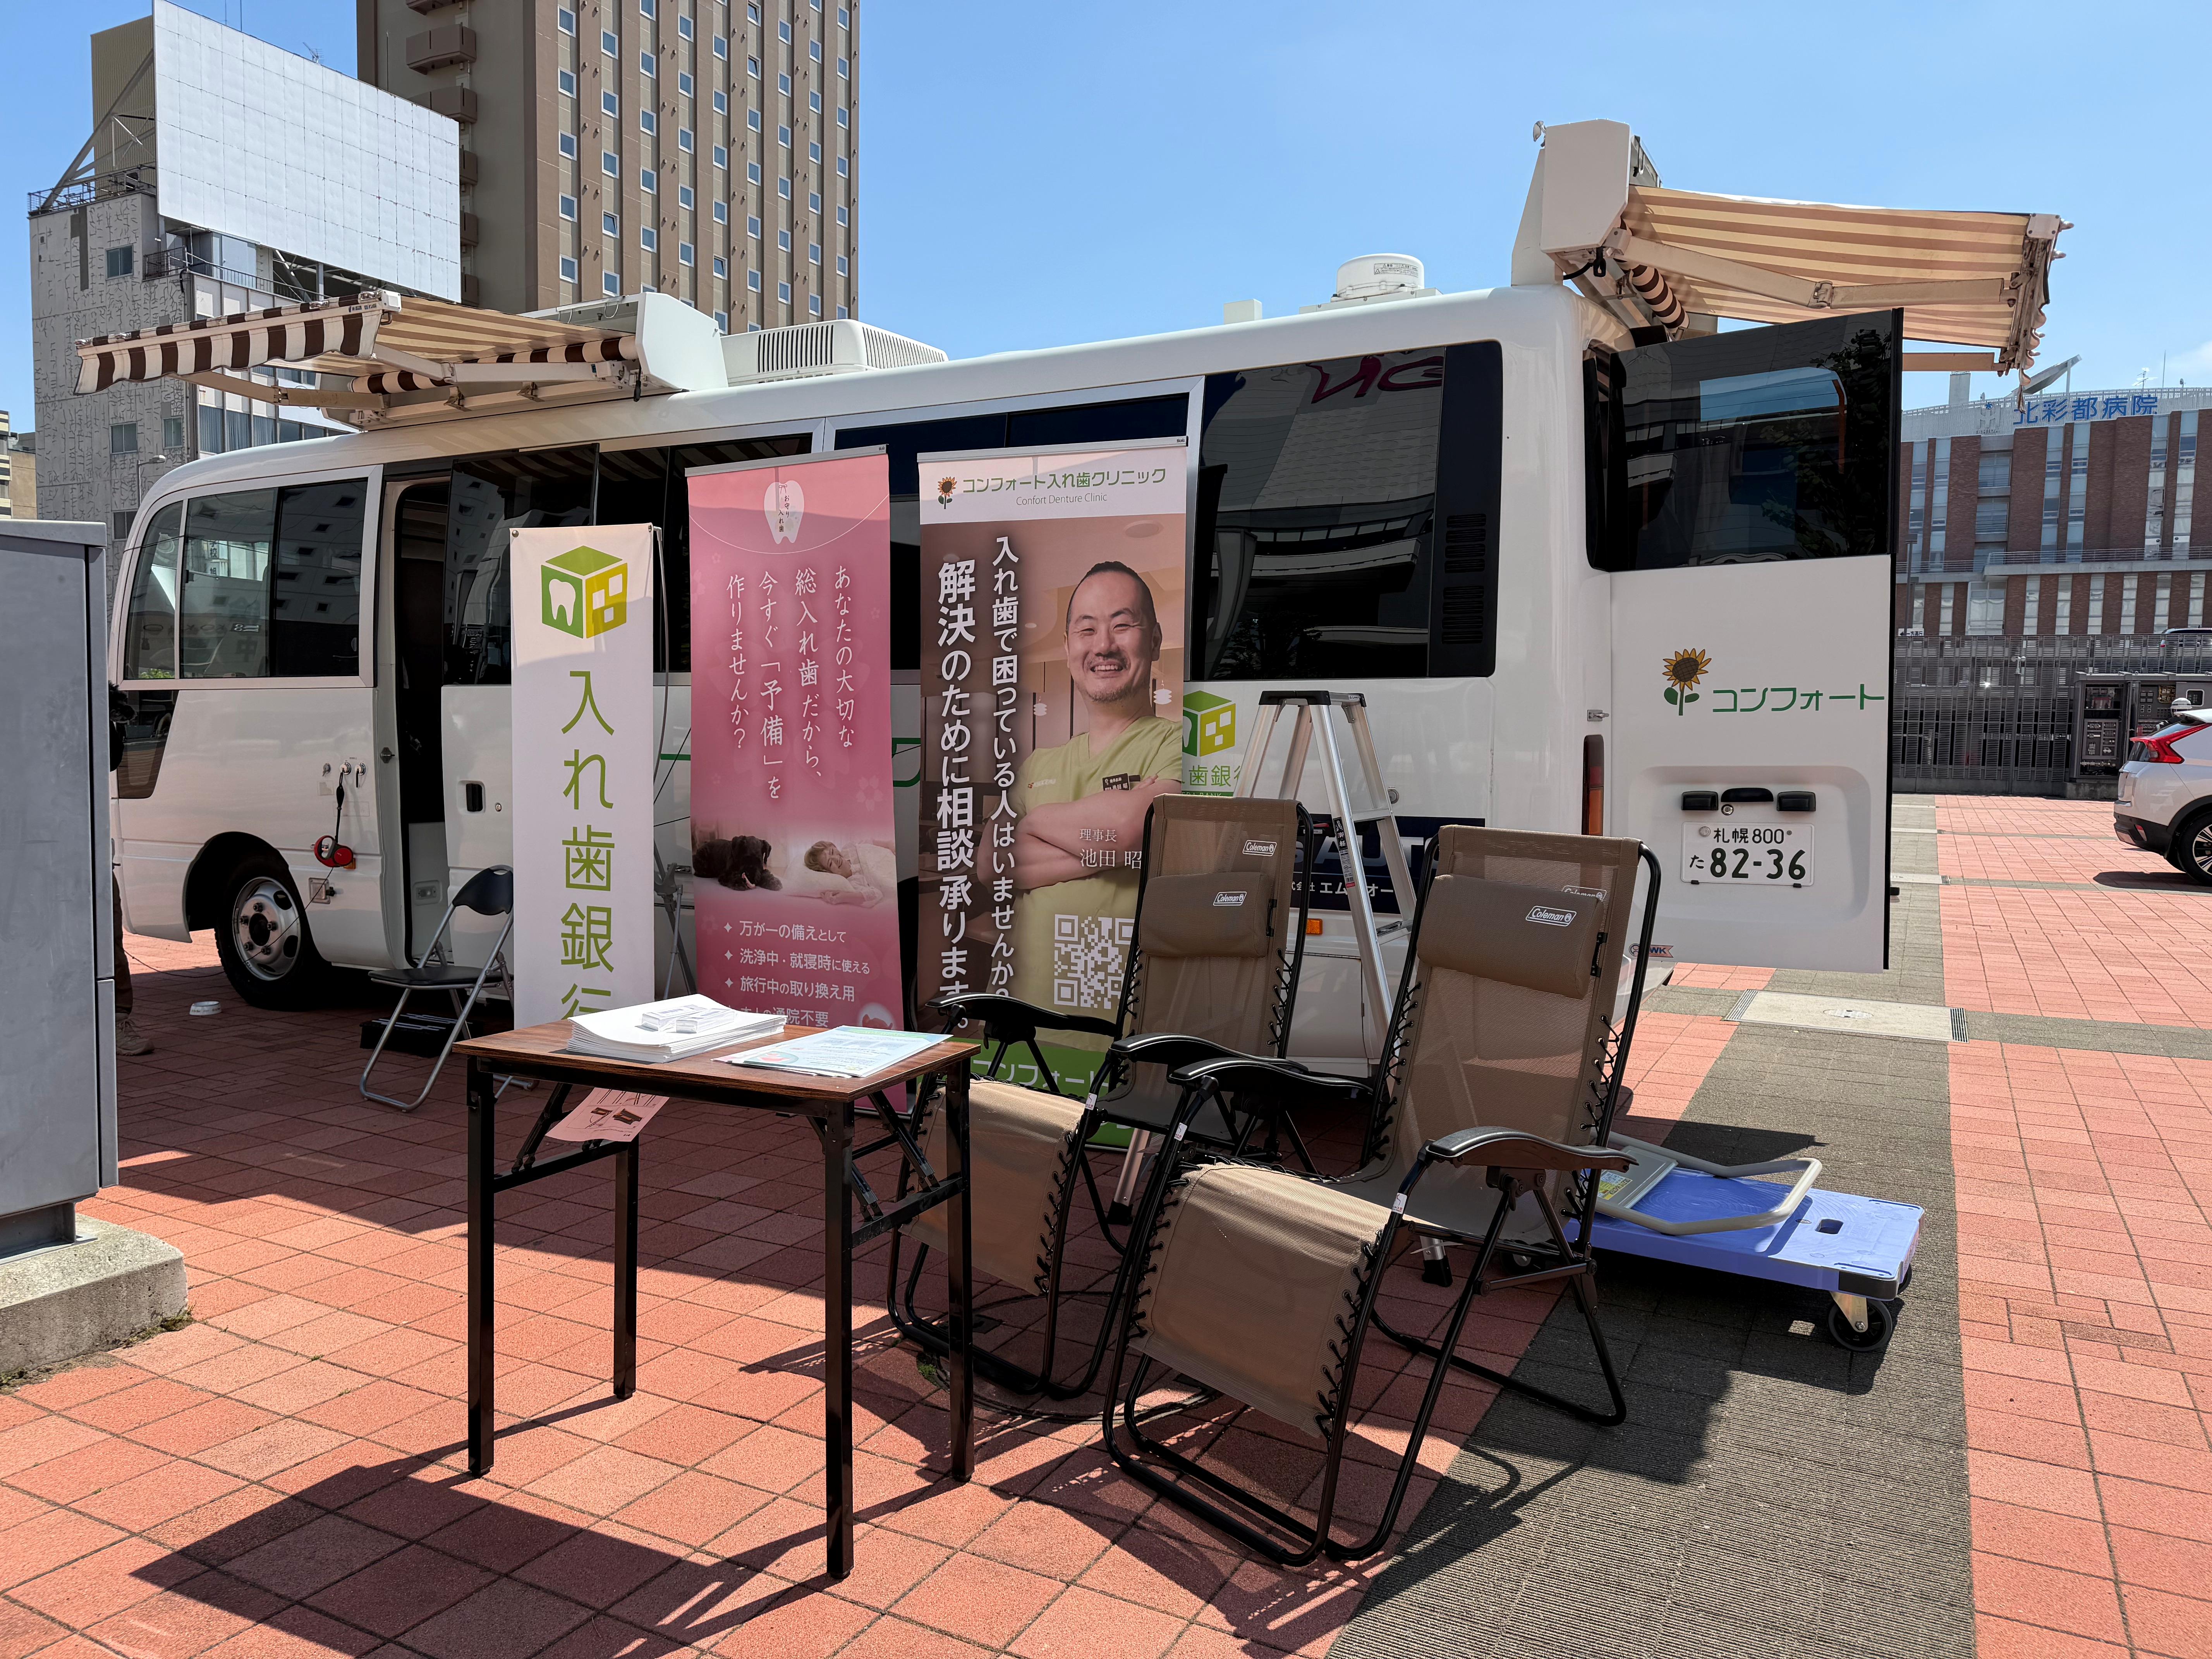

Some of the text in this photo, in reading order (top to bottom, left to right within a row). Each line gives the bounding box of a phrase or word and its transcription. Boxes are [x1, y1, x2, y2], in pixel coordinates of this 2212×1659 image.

[2013, 395, 2158, 425] 北彩都病院
[962, 469, 1166, 493] コンフォート入れ歯クリニック
[1016, 493, 1107, 506] Confort Denture Clinic
[726, 574, 749, 749] 作りませんか?
[834, 565, 855, 748] あなたの大切な
[795, 568, 822, 776] 総入れ歯だから、
[758, 571, 784, 799] 今すぐ「予備」を
[1713, 684, 1884, 712] コンフォート
[1080, 829, 1117, 842] 理事長
[1246, 842, 1269, 852] Coleman
[1714, 828, 1784, 844] 札幌 800
[1080, 848, 1142, 869] 池田 昭
[1690, 848, 1806, 880] た 82-36
[1217, 894, 1239, 902] Coleman
[1532, 908, 1565, 921] Coleman
[740, 921, 846, 943] 万が一の備えとして
[740, 948, 870, 974] 洗浄中・就寝時に使える
[740, 976, 854, 1002] 旅行中の取り換え用
